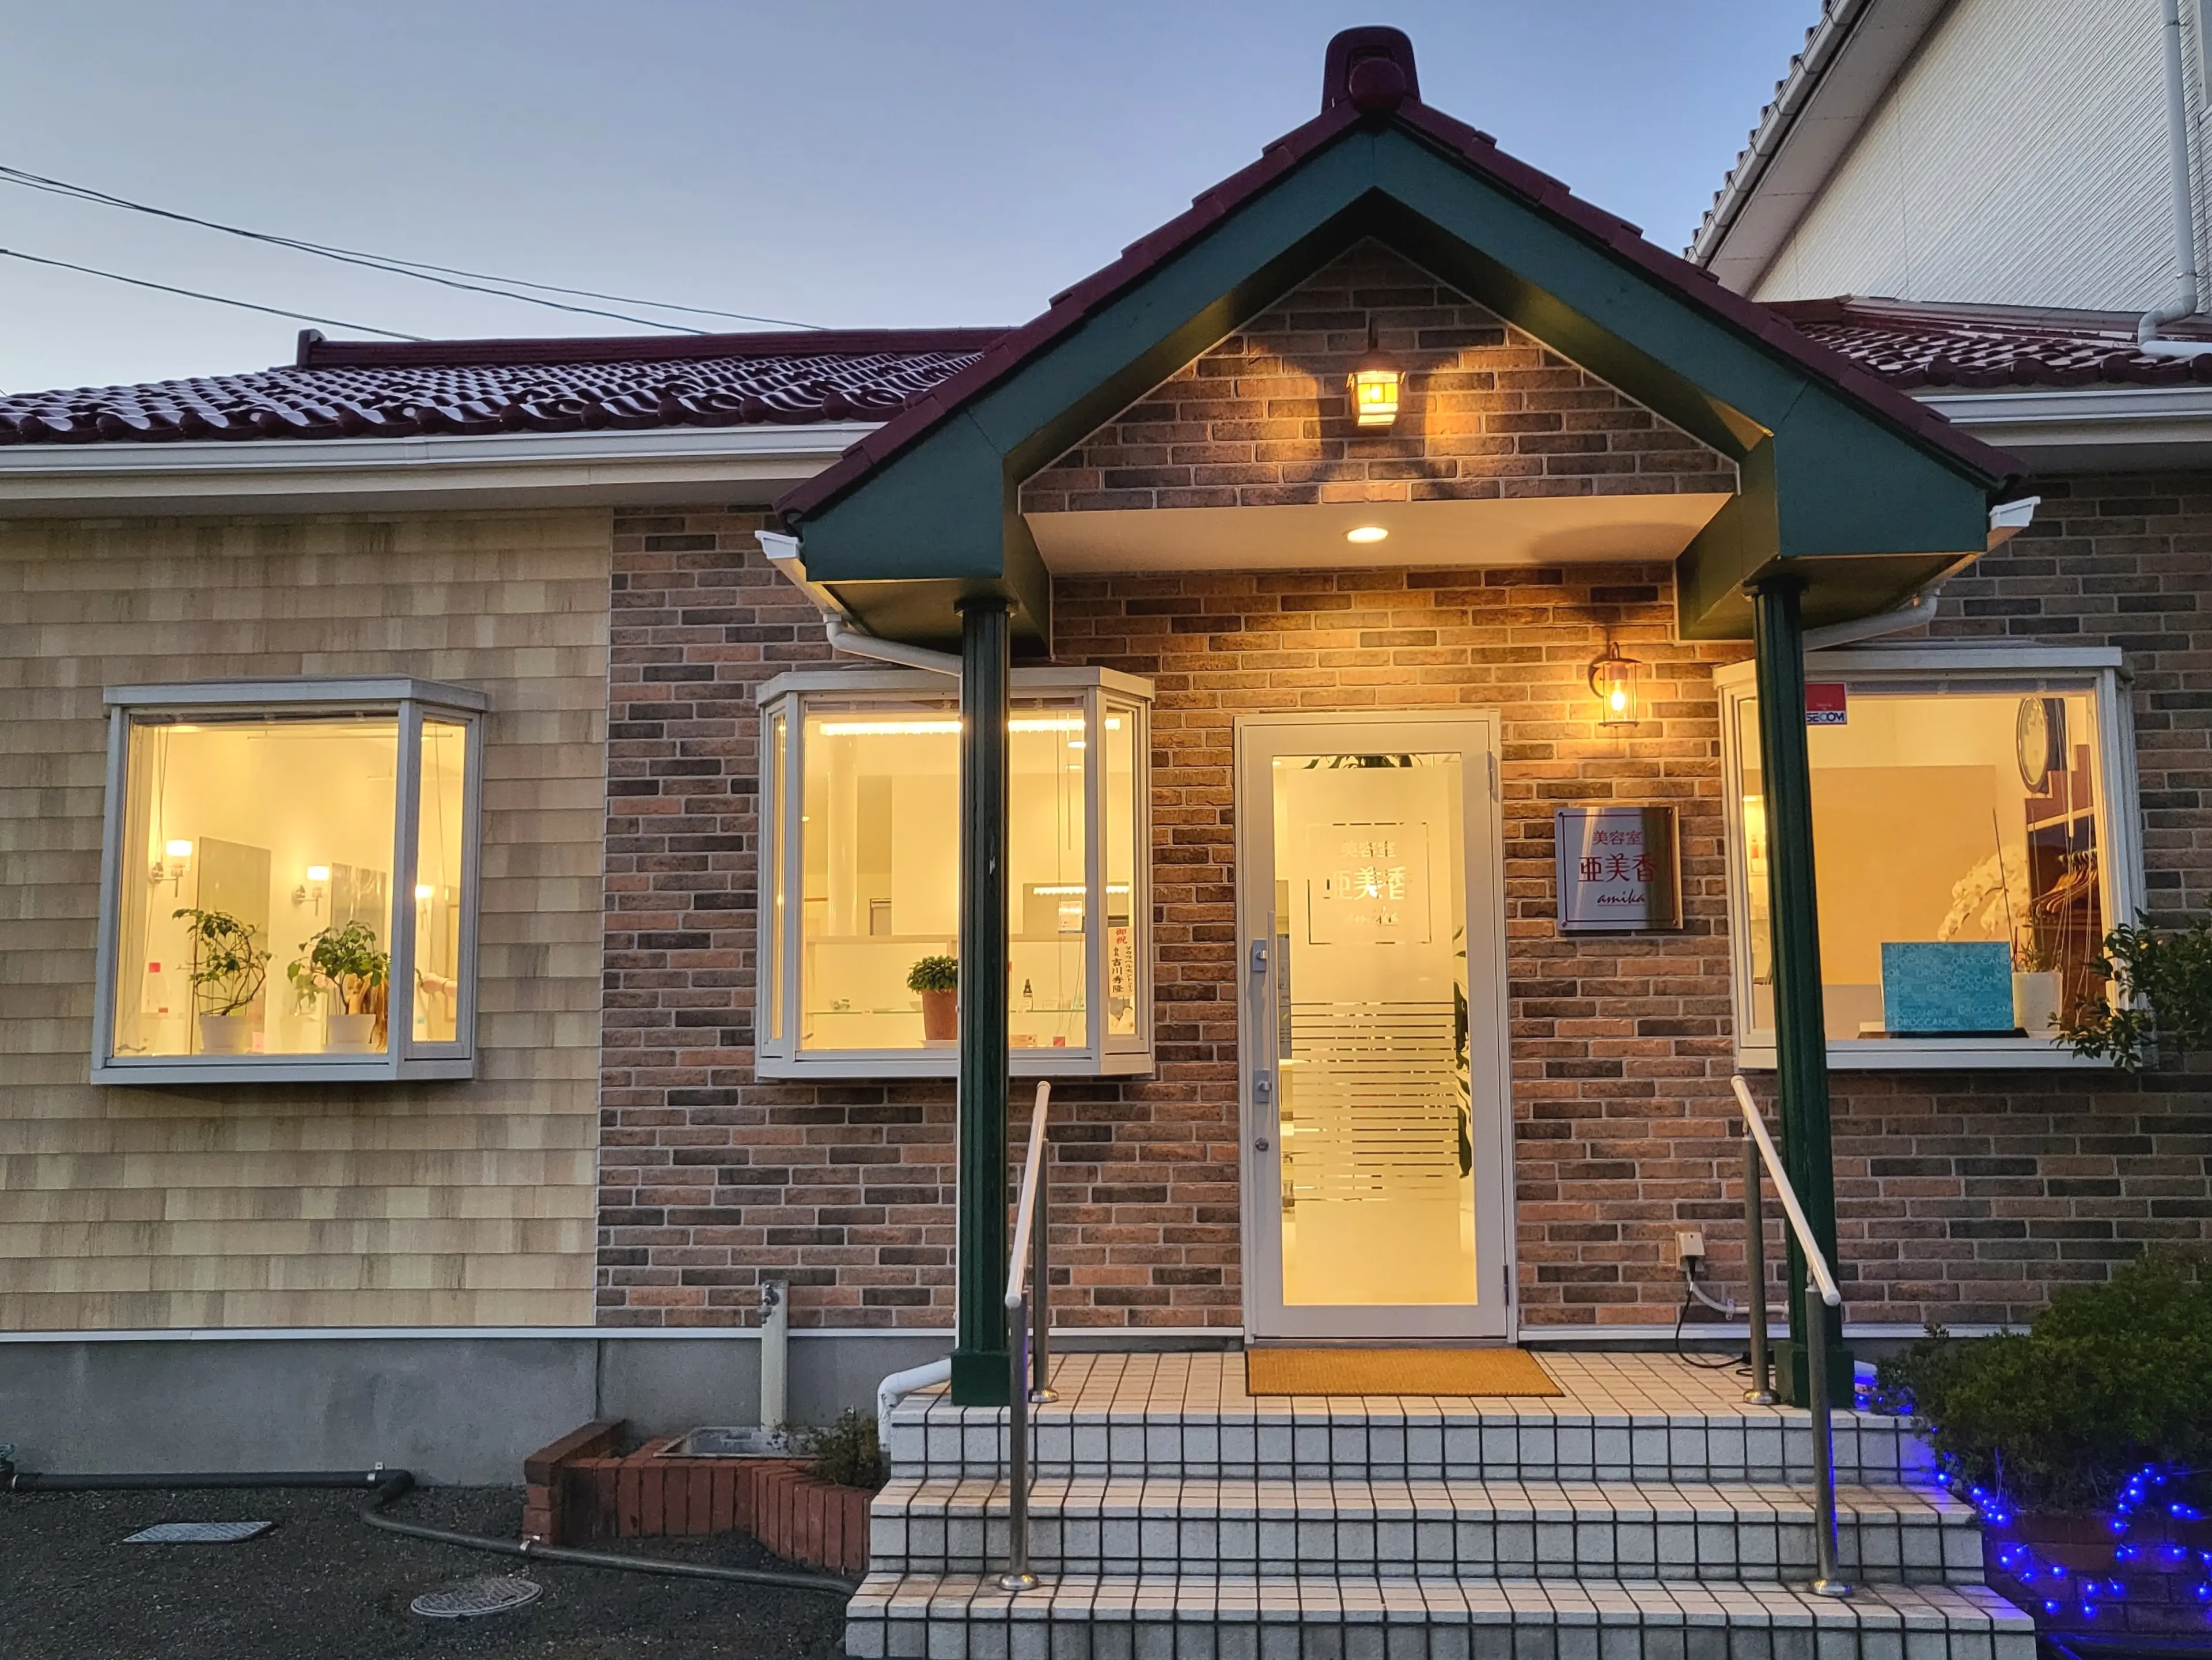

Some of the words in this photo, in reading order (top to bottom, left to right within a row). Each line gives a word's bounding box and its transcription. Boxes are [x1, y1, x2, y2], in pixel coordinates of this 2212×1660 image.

[1806, 712, 1844, 722] SECOM
[1593, 830, 1643, 845] 美容室
[1578, 853, 1655, 882] 亜美香
[1596, 889, 1646, 904] amika
[1116, 928, 1127, 944] 御祝
